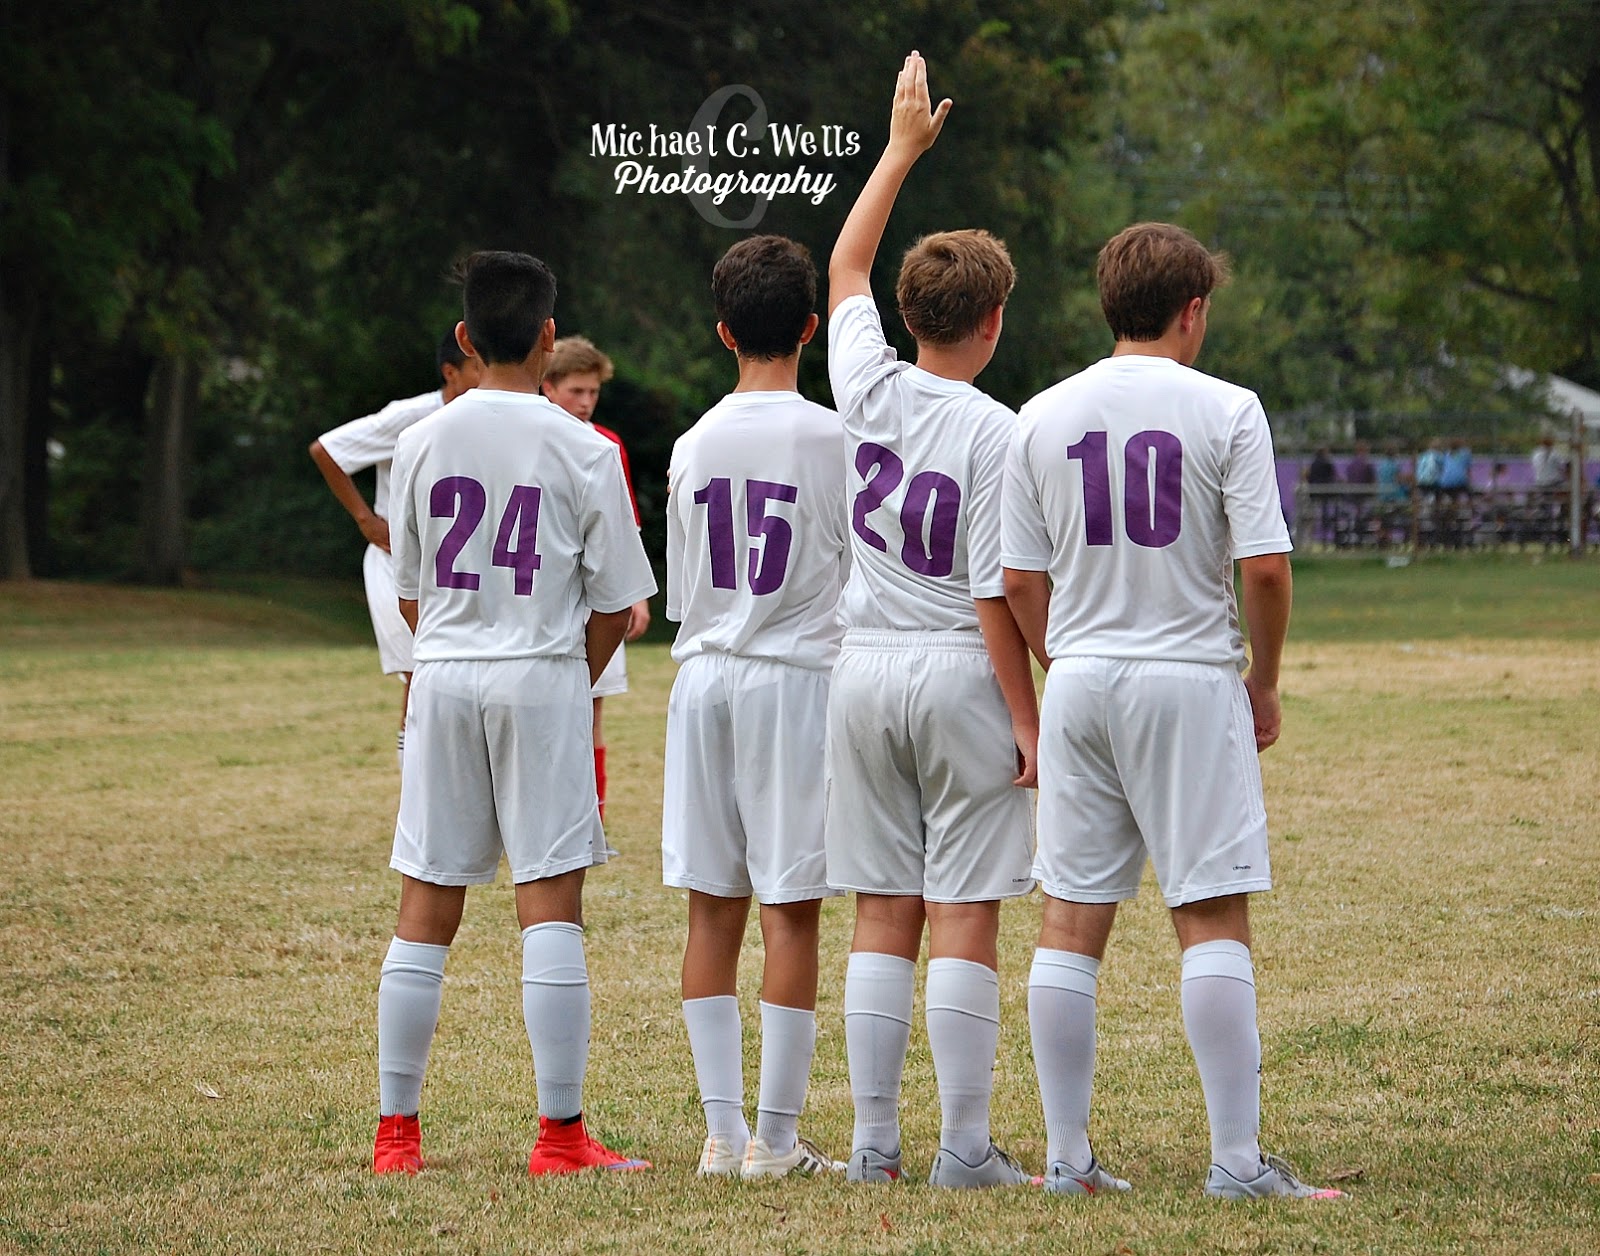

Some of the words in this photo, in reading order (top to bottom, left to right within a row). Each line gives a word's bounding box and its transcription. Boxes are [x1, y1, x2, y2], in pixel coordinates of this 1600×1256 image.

[429, 475, 542, 597] 24
[694, 477, 798, 596] 15
[854, 442, 960, 578] 20
[1066, 430, 1182, 548] 10
